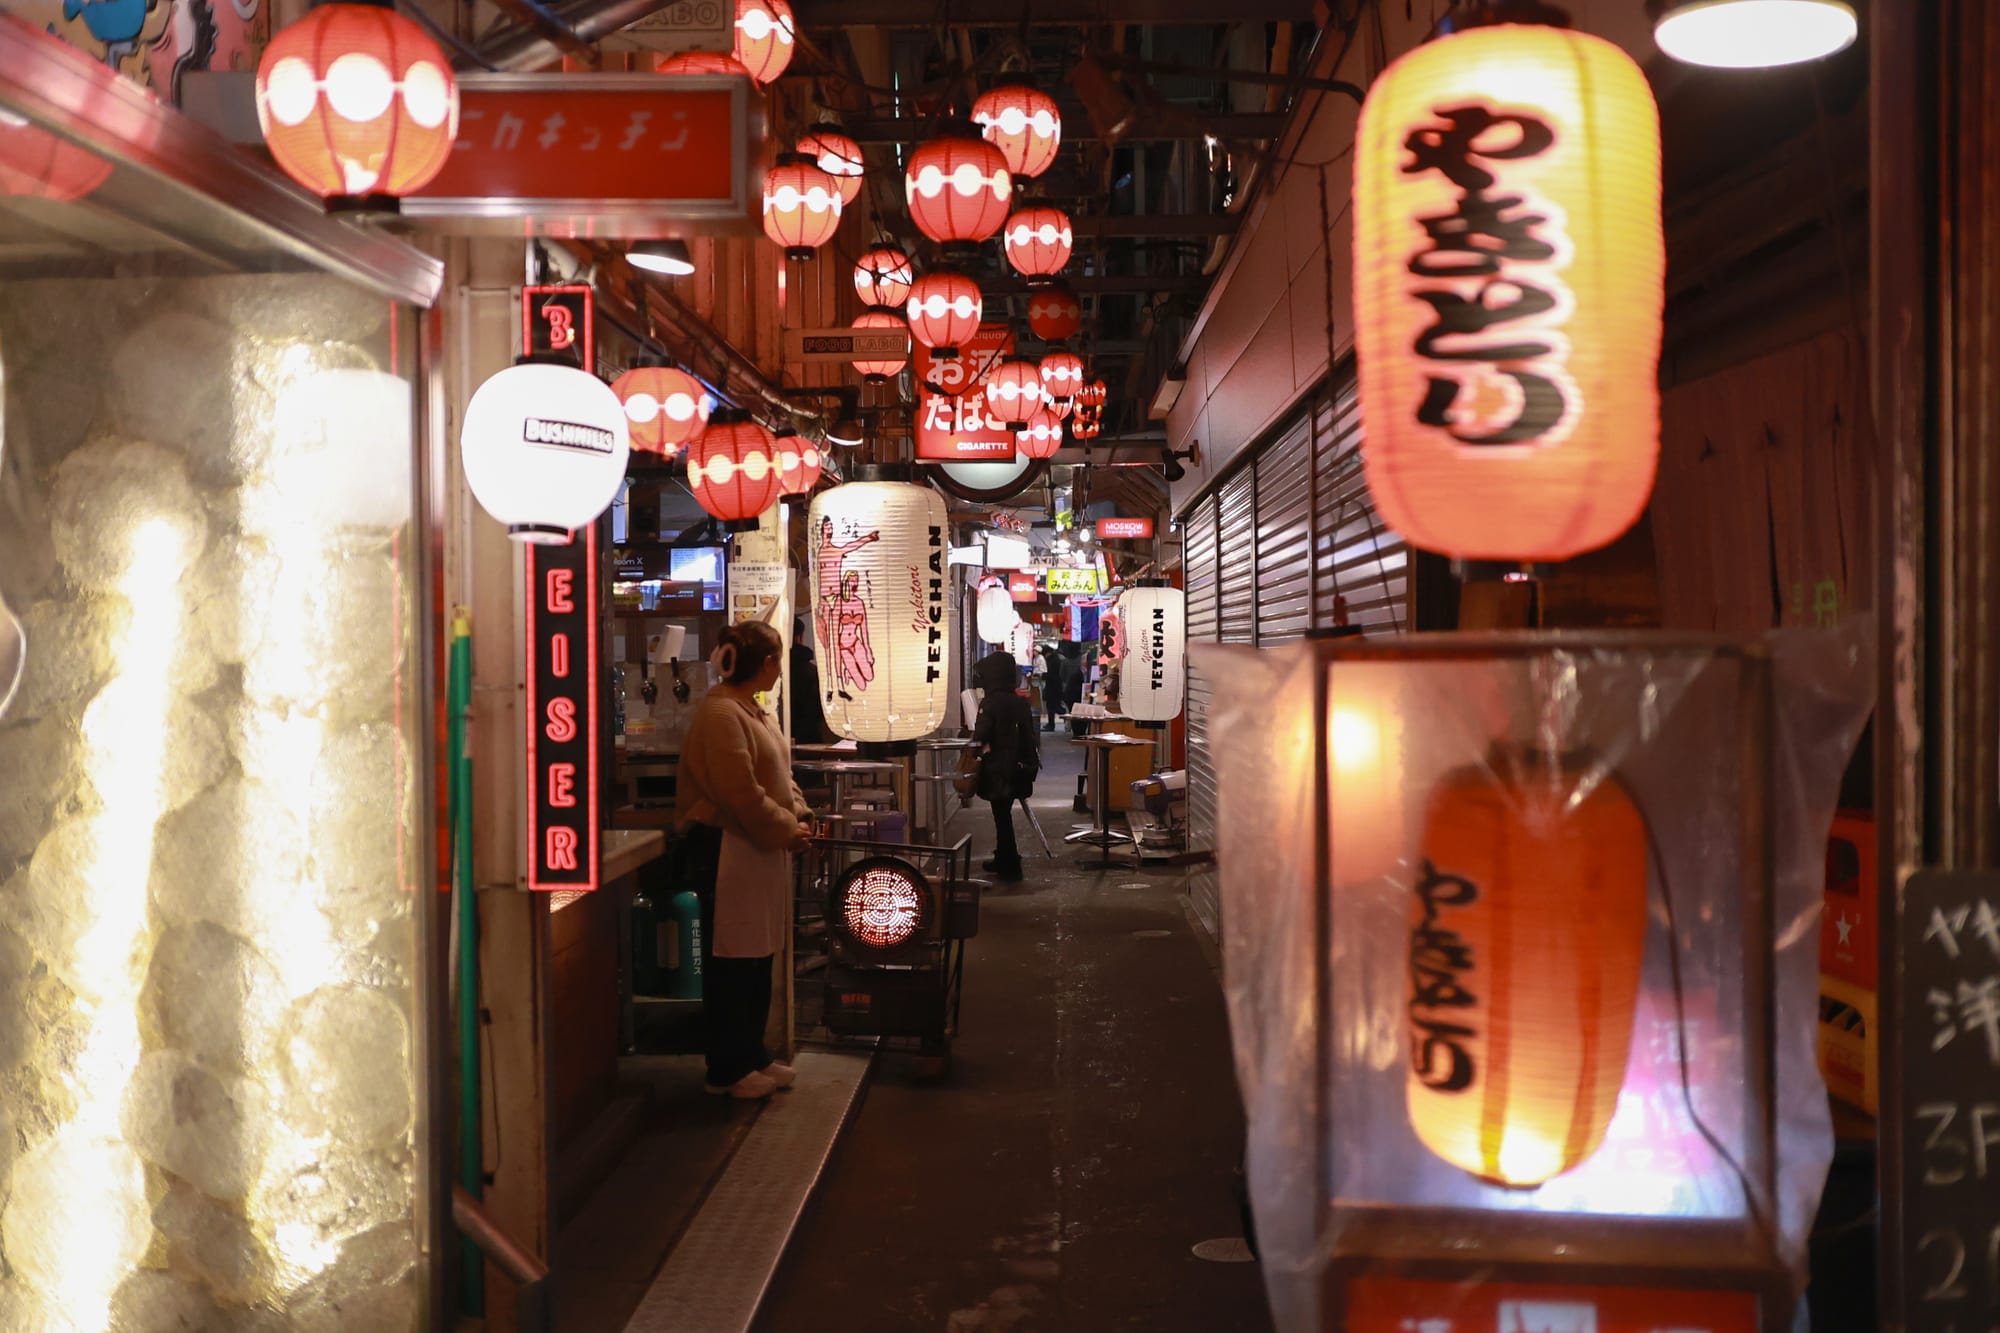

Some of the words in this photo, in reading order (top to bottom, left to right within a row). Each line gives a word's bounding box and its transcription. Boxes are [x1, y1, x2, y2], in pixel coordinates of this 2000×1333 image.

[640, 2, 699, 26] ABO
[1400, 104, 1566, 447] やきとり
[855, 337, 904, 352] LABO
[526, 419, 612, 453] BUSHMILLS
[956, 442, 1008, 451] CIGARETTE
[1105, 522, 1144, 530] MOSKOW
[541, 304, 578, 871] BEISER
[909, 565, 931, 634] Yakitori
[1050, 580, 1094, 591] みんみん
[927, 526, 942, 683] TETCHAN
[1151, 608, 1164, 690] TETCHAN
